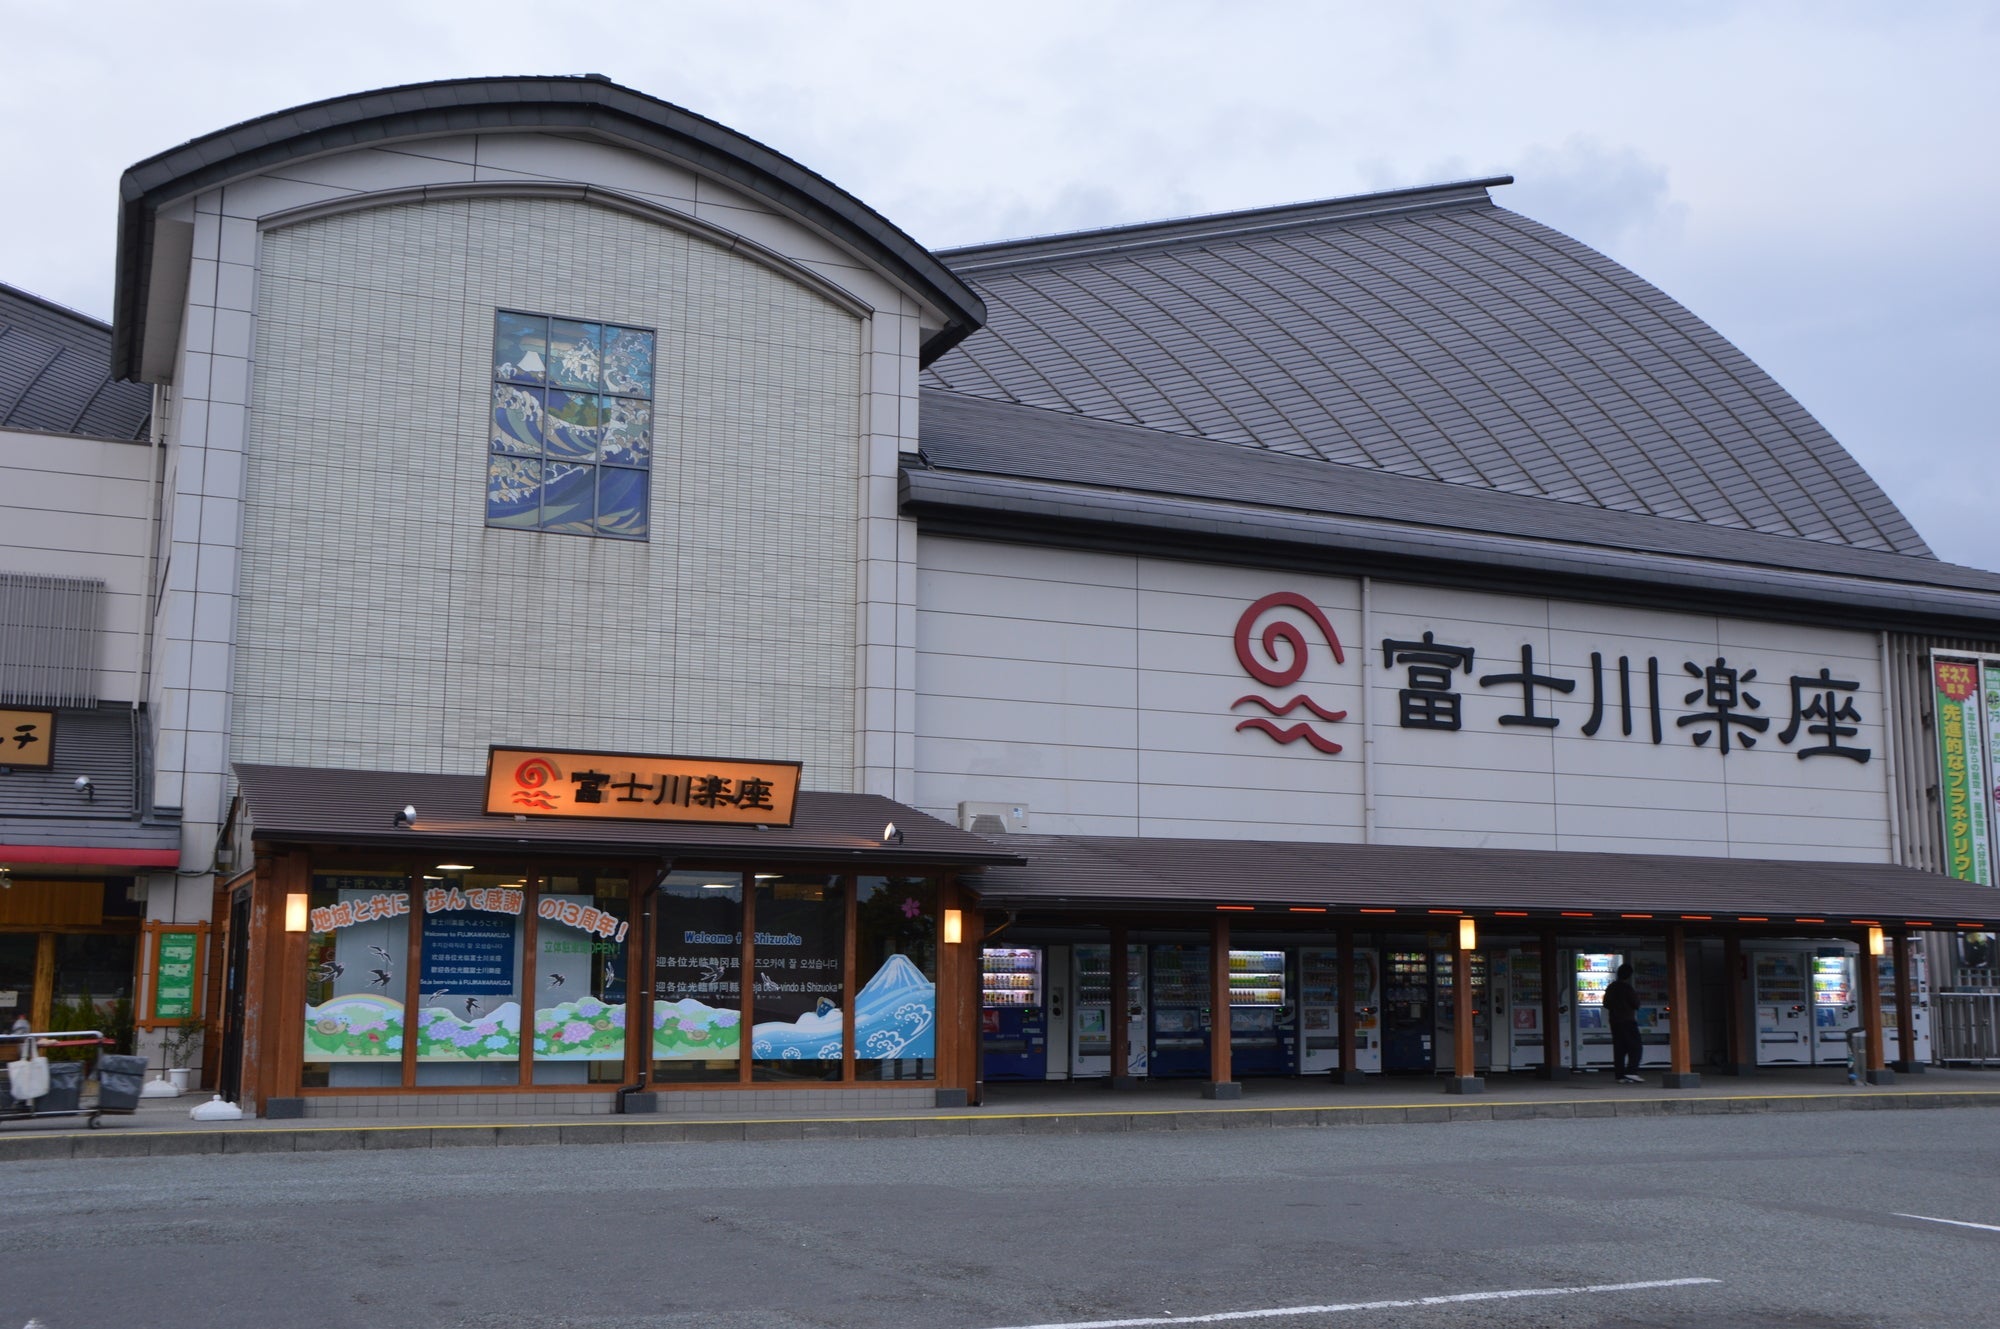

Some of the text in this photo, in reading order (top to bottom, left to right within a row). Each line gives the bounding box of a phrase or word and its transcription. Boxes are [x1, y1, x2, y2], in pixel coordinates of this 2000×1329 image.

[1939, 666, 1970, 683] ギネス
[1383, 631, 1870, 763] 富士川楽座
[571, 769, 774, 810] 富士川楽座
[311, 893, 410, 933] 地域と共に
[425, 886, 524, 915] 歩んで感謝
[685, 931, 732, 944] Welcome
[753, 933, 802, 946] Shizuoka
[807, 982, 838, 992] Shizuoka
